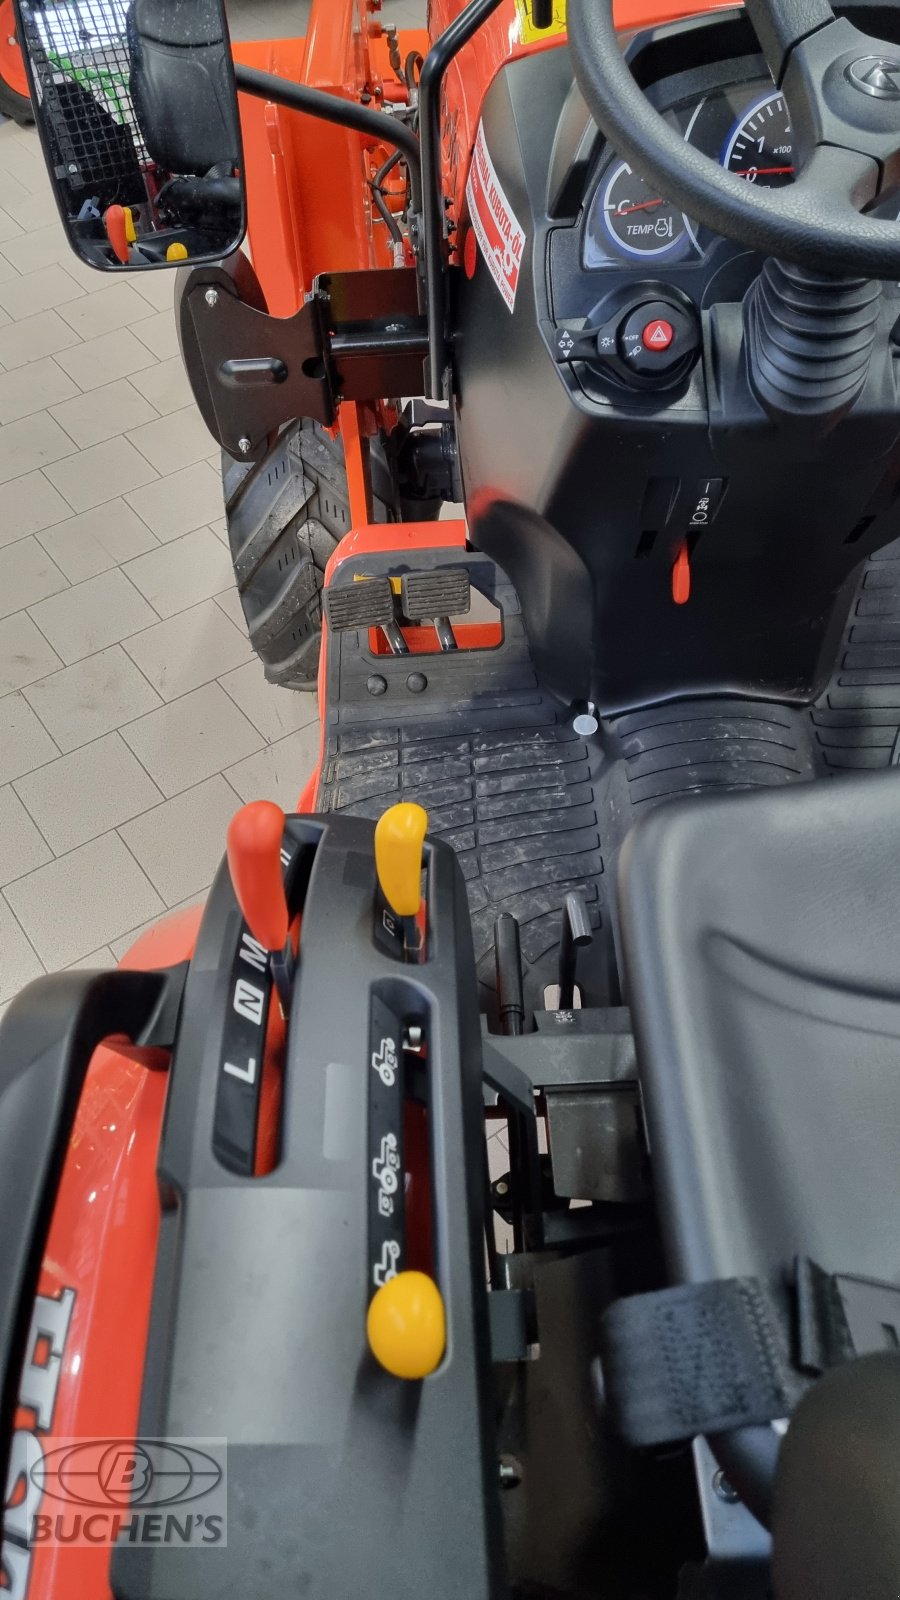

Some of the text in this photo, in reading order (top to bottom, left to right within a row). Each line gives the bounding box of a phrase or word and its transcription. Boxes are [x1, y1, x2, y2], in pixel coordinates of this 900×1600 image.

[756, 136, 766, 153] 1
[626, 224, 654, 236] TEMP
[239, 932, 269, 973] M
[237, 985, 262, 1017] N
[223, 1057, 257, 1085] L
